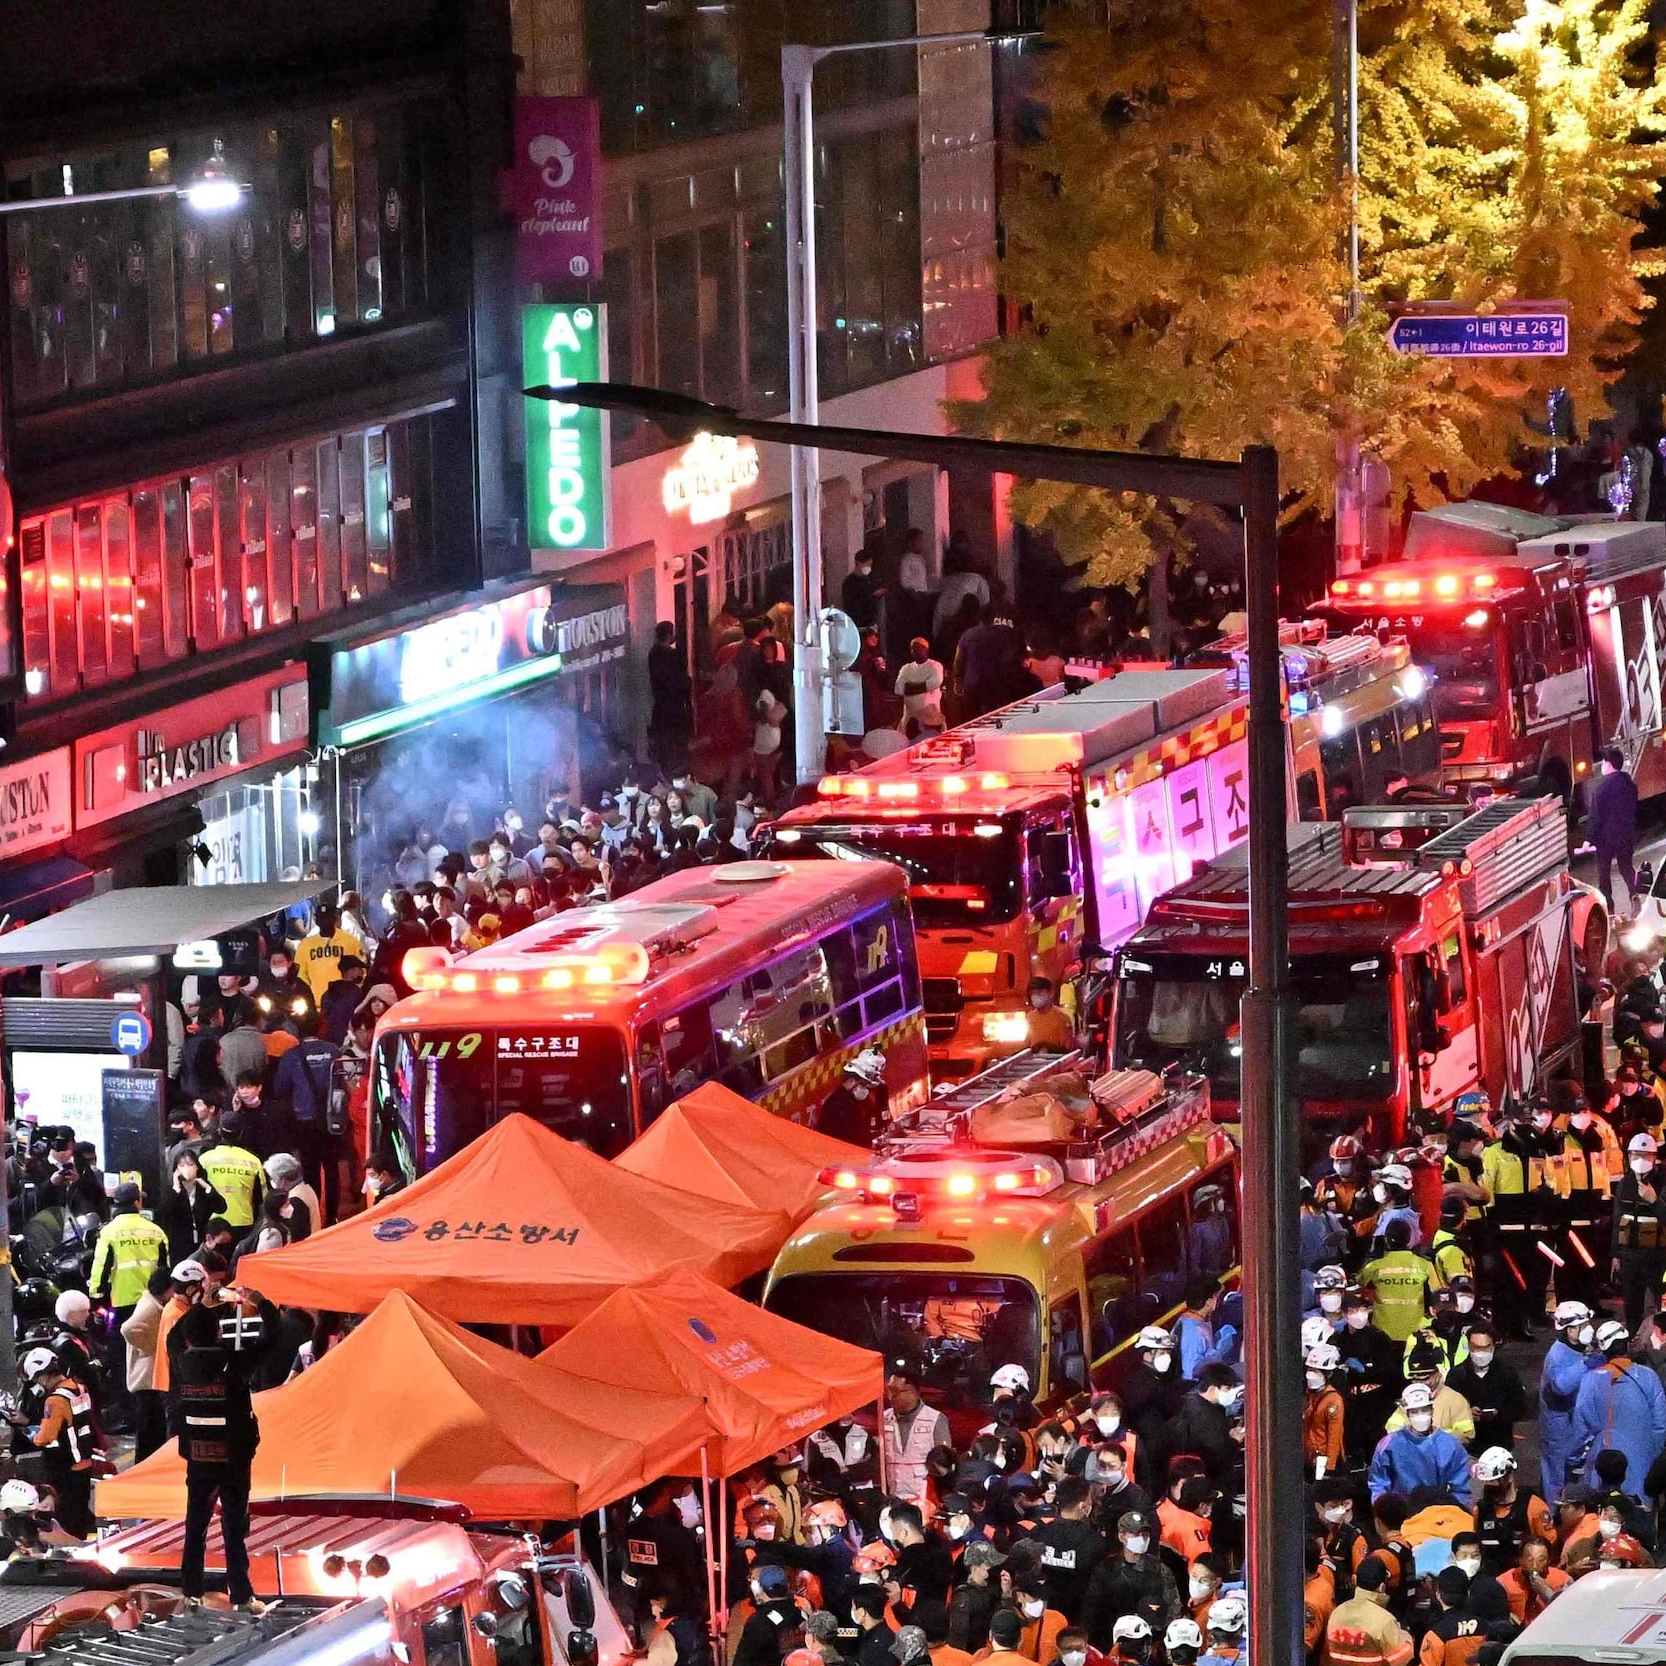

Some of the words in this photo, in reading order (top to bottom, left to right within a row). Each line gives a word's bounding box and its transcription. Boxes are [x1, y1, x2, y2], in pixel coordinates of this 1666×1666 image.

[535, 198, 577, 216] Pink
[1470, 340, 1528, 350] Itaewon-ro
[1532, 340, 1562, 352] 26-gil
[543, 313, 586, 546] ALPEDO
[143, 731, 239, 793] PLASTIC
[498, 1036, 580, 1051] 특수구조대
[212, 1167, 252, 1178] POLICE
[423, 1220, 580, 1246] 용산소방서
